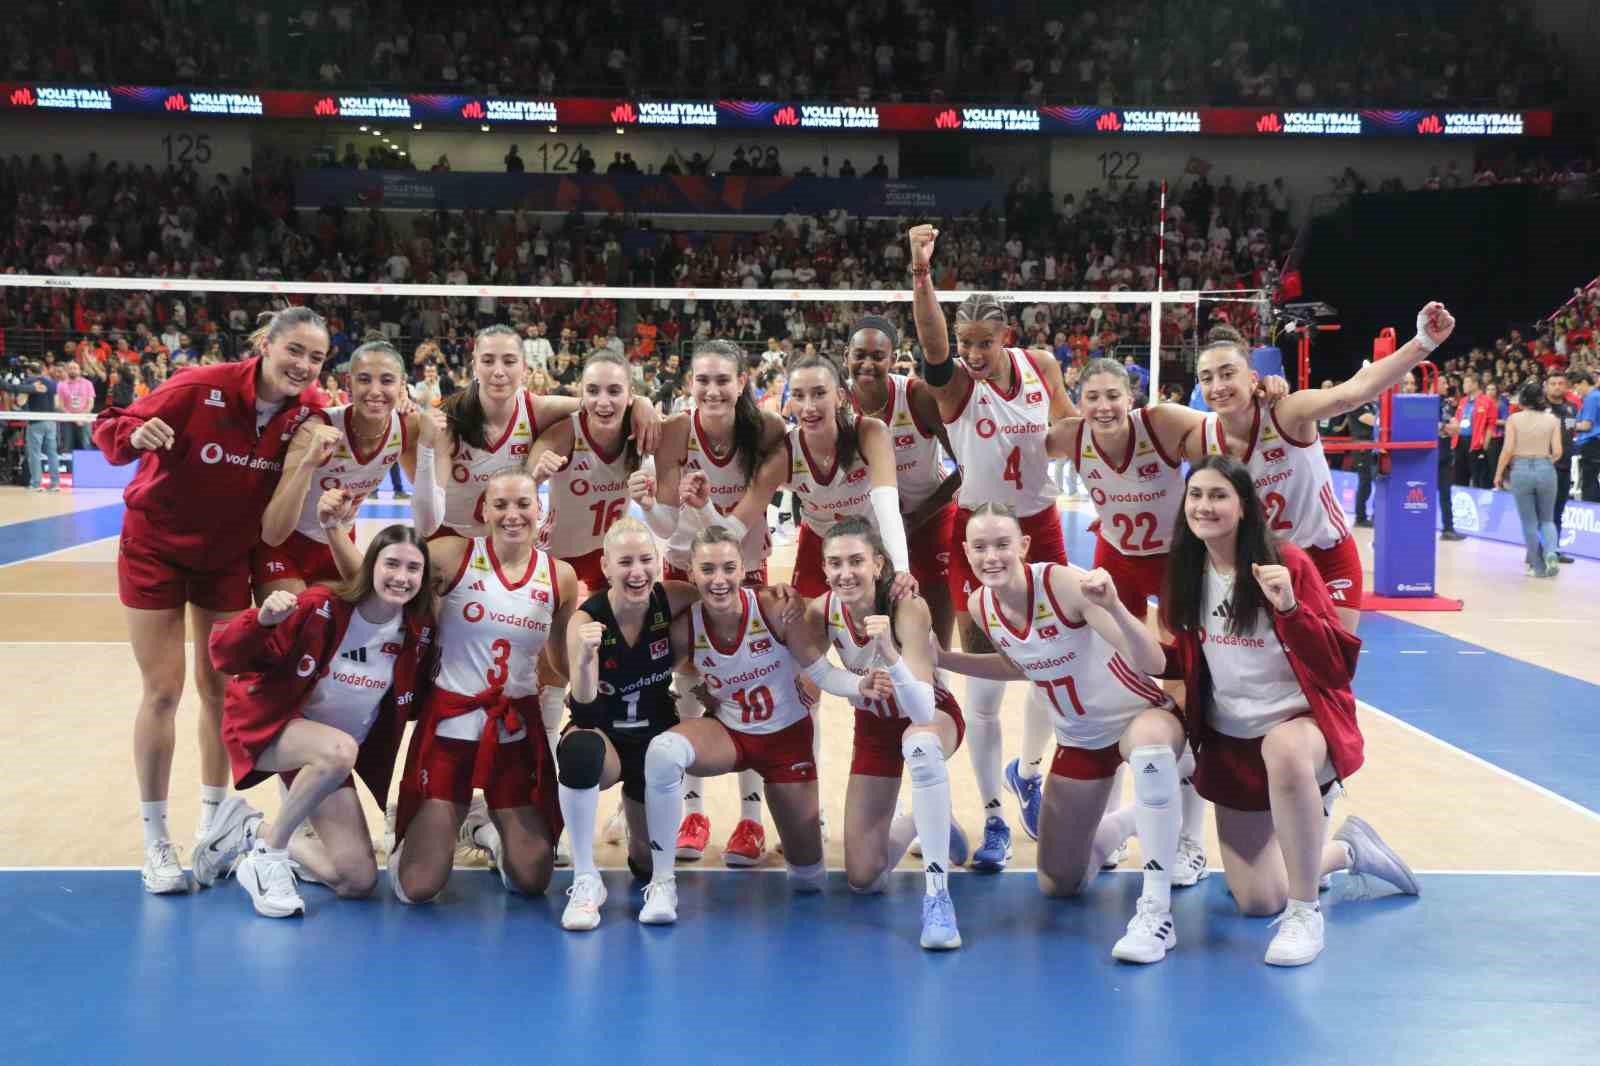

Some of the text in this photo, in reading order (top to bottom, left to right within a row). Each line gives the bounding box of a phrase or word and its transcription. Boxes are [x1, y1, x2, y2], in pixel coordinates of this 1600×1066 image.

[37, 88, 111, 102] VOLLEYBALL
[190, 93, 262, 107] VOLLEYBALL
[37, 98, 112, 110] NATIONS LEAGUE
[190, 104, 262, 115] NATIONS LEAGUE
[339, 98, 411, 110] VOLLEYBALL
[486, 101, 557, 113] VOLLEYBALL
[639, 103, 717, 116] VOLLEYBALL
[339, 108, 411, 119] NATIONS LEAGUE
[486, 111, 557, 121] NATIONS LEAGUE
[801, 106, 879, 119] VOLLEYBALL
[963, 109, 1040, 121] VOLLEYBALL
[1123, 111, 1200, 123] VOLLEYBALL
[639, 114, 717, 125] NATIONS LEAGUE
[801, 118, 879, 128] NATIONS LEAGUE
[963, 120, 1040, 130] NATIONS LEAGUE
[1284, 113, 1361, 125] VOLLEYBALL
[1445, 114, 1523, 126] VOLLEYBALL
[1123, 122, 1200, 132] NATIONS LEAGUE
[1284, 124, 1361, 134] NATIONS LEAGUE
[1445, 125, 1523, 135] NATIONS LEAGUE
[162, 134, 211, 164] 125
[1097, 152, 1140, 180] 122
[1003, 446, 1023, 490] 4
[1255, 469, 1294, 488] dafone
[592, 480, 626, 492] vodaf
[1109, 489, 1167, 502] vodafone
[1113, 512, 1163, 550] 22
[266, 561, 285, 573] 15
[489, 611, 549, 632] vodafone
[487, 639, 511, 687] 3
[1023, 651, 1077, 671] vodafone
[725, 660, 781, 685] vodafone
[332, 671, 386, 689] vodafone
[621, 690, 641, 722] 1
[732, 684, 774, 723] 10
[420, 769, 429, 785] 3
